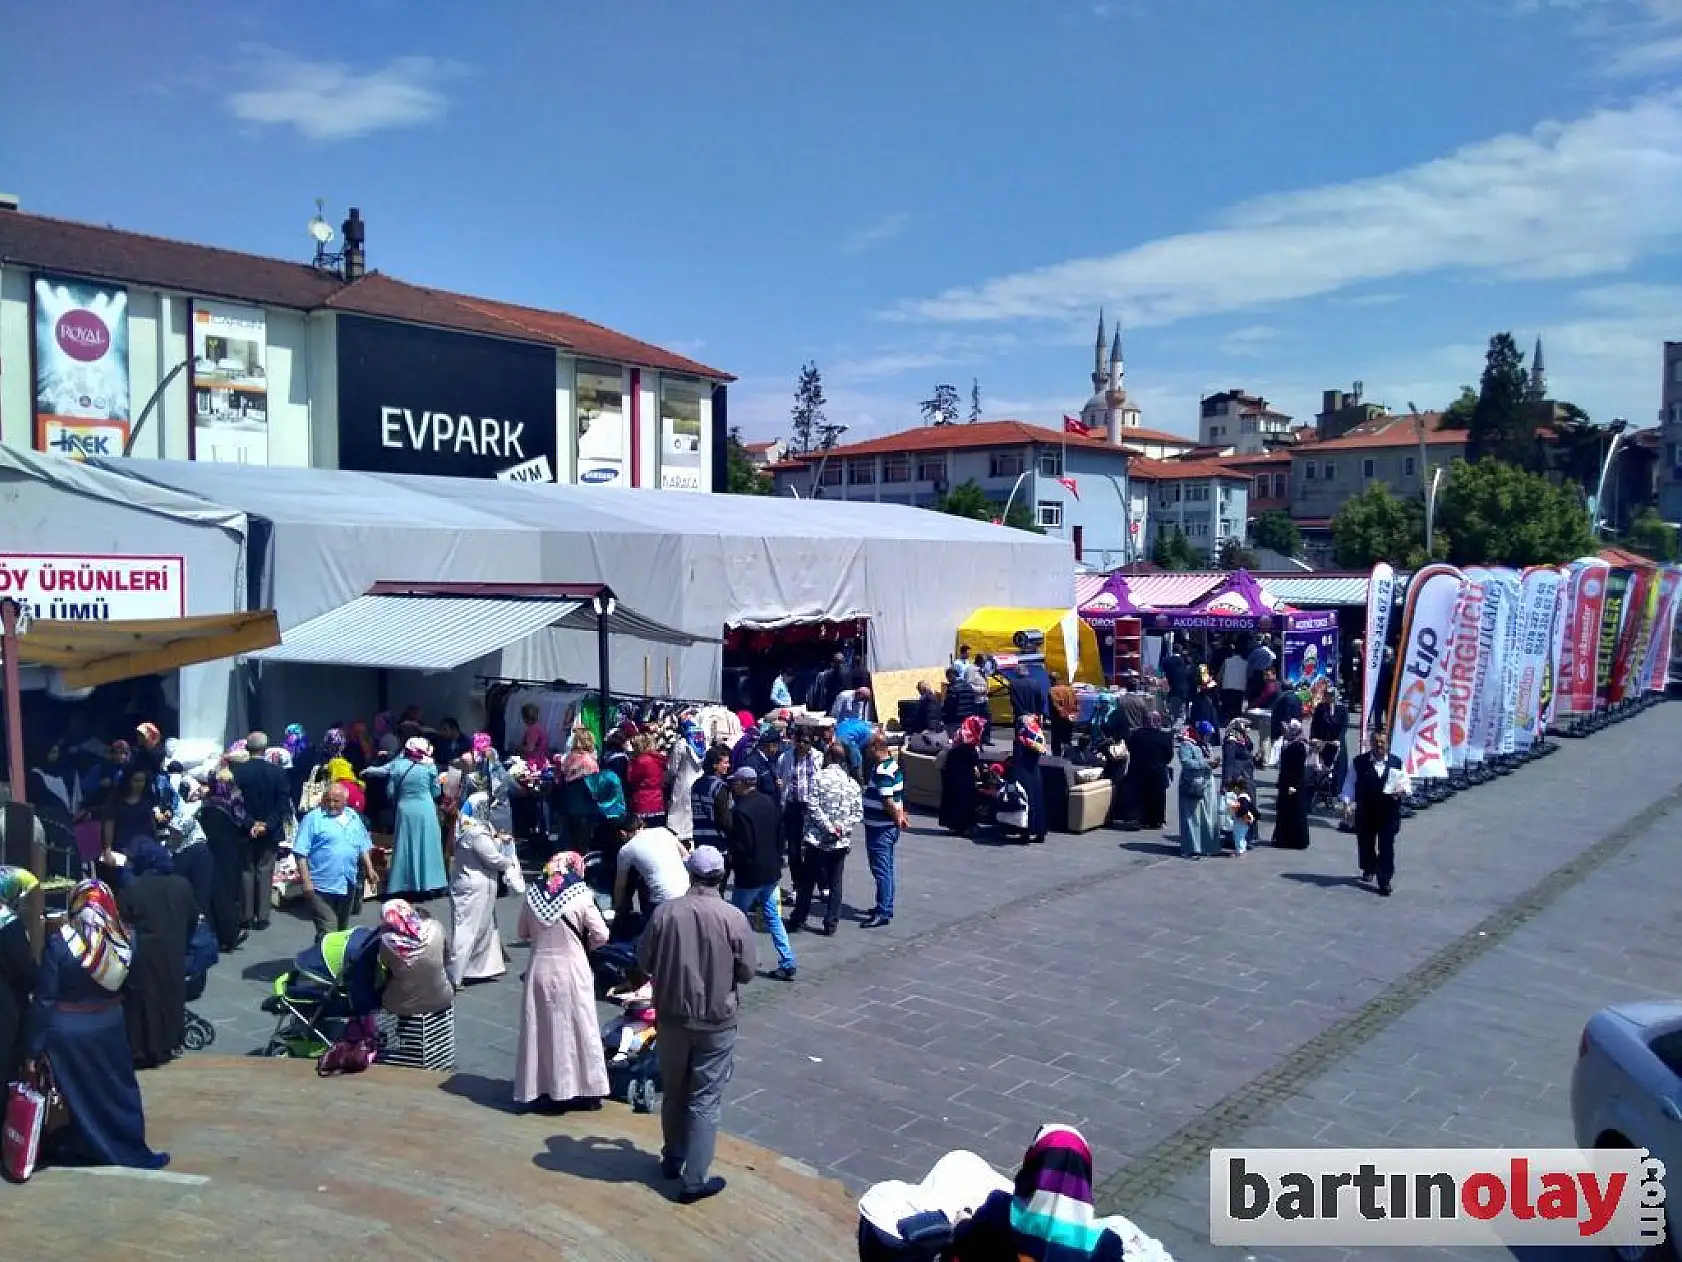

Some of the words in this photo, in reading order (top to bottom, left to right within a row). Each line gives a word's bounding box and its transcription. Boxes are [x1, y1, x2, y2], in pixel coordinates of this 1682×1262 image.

[60, 324, 101, 342] ROYAL
[380, 405, 524, 458] EVPARK
[509, 464, 542, 484] AVM
[39, 563, 168, 591] ÜRÜNLERİ
[1173, 615, 1215, 628] AKDENİZ
[1217, 617, 1254, 629] TOROS
